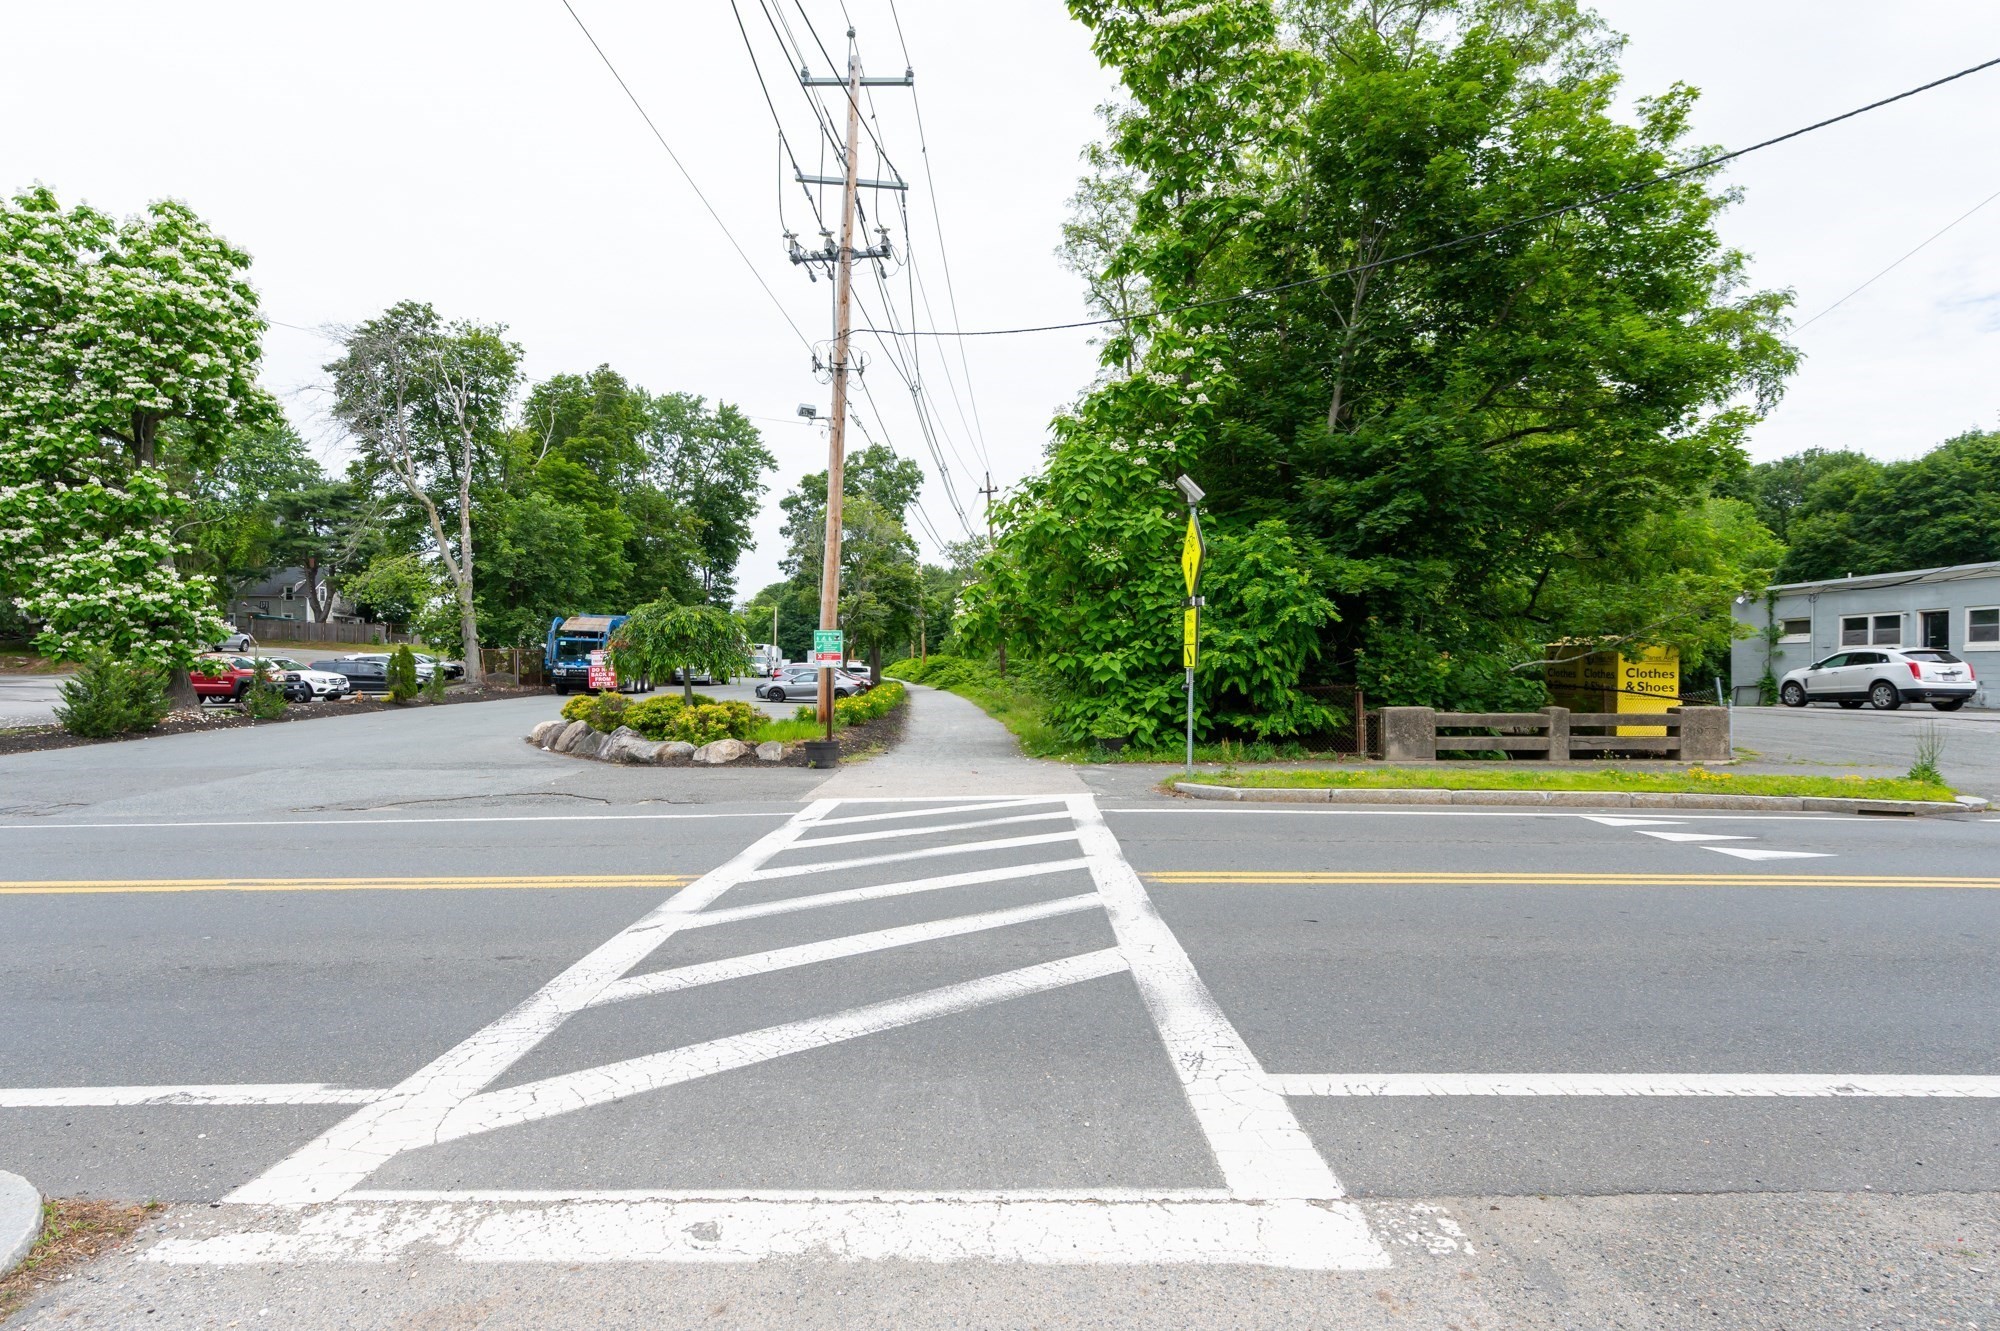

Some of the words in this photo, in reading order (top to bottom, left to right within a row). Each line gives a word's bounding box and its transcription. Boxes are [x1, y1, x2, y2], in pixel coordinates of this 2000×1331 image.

[1547, 668, 1577, 678] Clothes
[1584, 668, 1615, 679] Clothes
[1625, 668, 1675, 679] Clothes
[1625, 681, 1635, 692] &
[1637, 681, 1675, 692] Shoes
